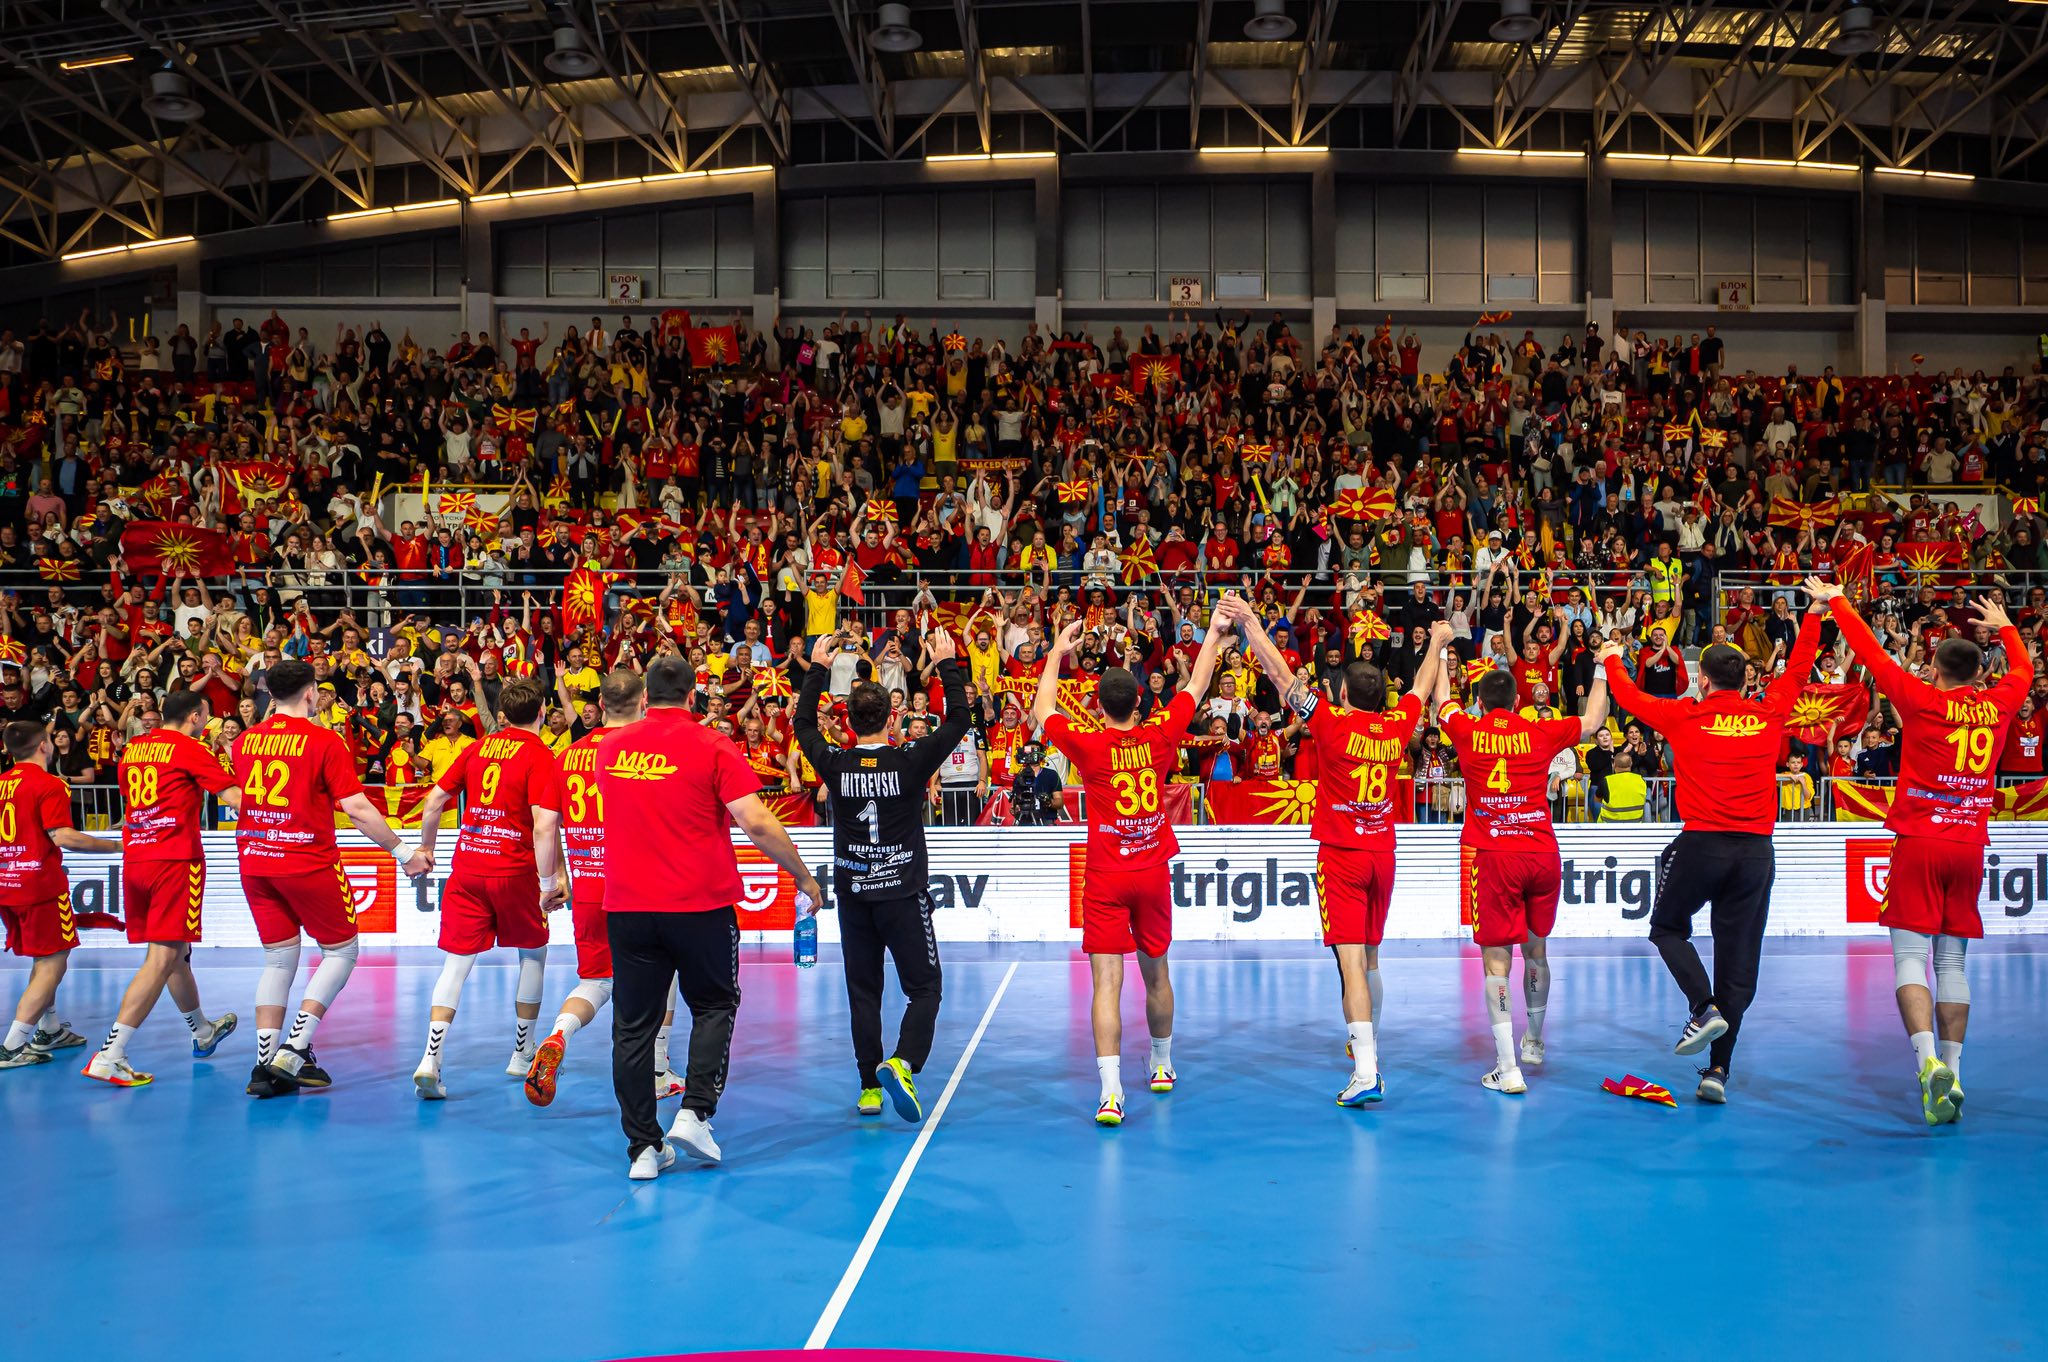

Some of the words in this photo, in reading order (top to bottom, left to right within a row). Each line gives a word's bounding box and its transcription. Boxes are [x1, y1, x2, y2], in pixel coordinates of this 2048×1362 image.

[610, 275, 639, 284] БЛОК
[619, 284, 630, 298] 2
[1172, 277, 1200, 286] БЛОК
[1720, 281, 1747, 290] БЛОК
[1181, 286, 1192, 300] 3
[1729, 290, 1739, 304] 4
[969, 461, 1022, 469] MACEDNIA
[1711, 713, 1760, 729] MKD
[241, 733, 309, 757] STOJKOVIKJ
[1472, 730, 1532, 755] VELKOVSKI
[1945, 724, 1995, 774] 19
[613, 750, 667, 769] MKD
[1110, 742, 1153, 772] DJONOV
[127, 764, 159, 808] 88
[244, 759, 291, 808] 42
[479, 762, 502, 806] 9
[840, 770, 901, 798] MITREVSKI
[1348, 761, 1388, 804] 18
[1486, 757, 1512, 794] 4
[566, 774, 604, 823] 31
[1110, 768, 1159, 816] 38
[855, 799, 880, 845] 1
[250, 848, 268, 857] Grand
[466, 845, 485, 854] Grand
[862, 881, 884, 890] Grand
[884, 880, 902, 888] Auto
[867, 868, 898, 878] CHERY
[1172, 858, 1318, 922] trigla
